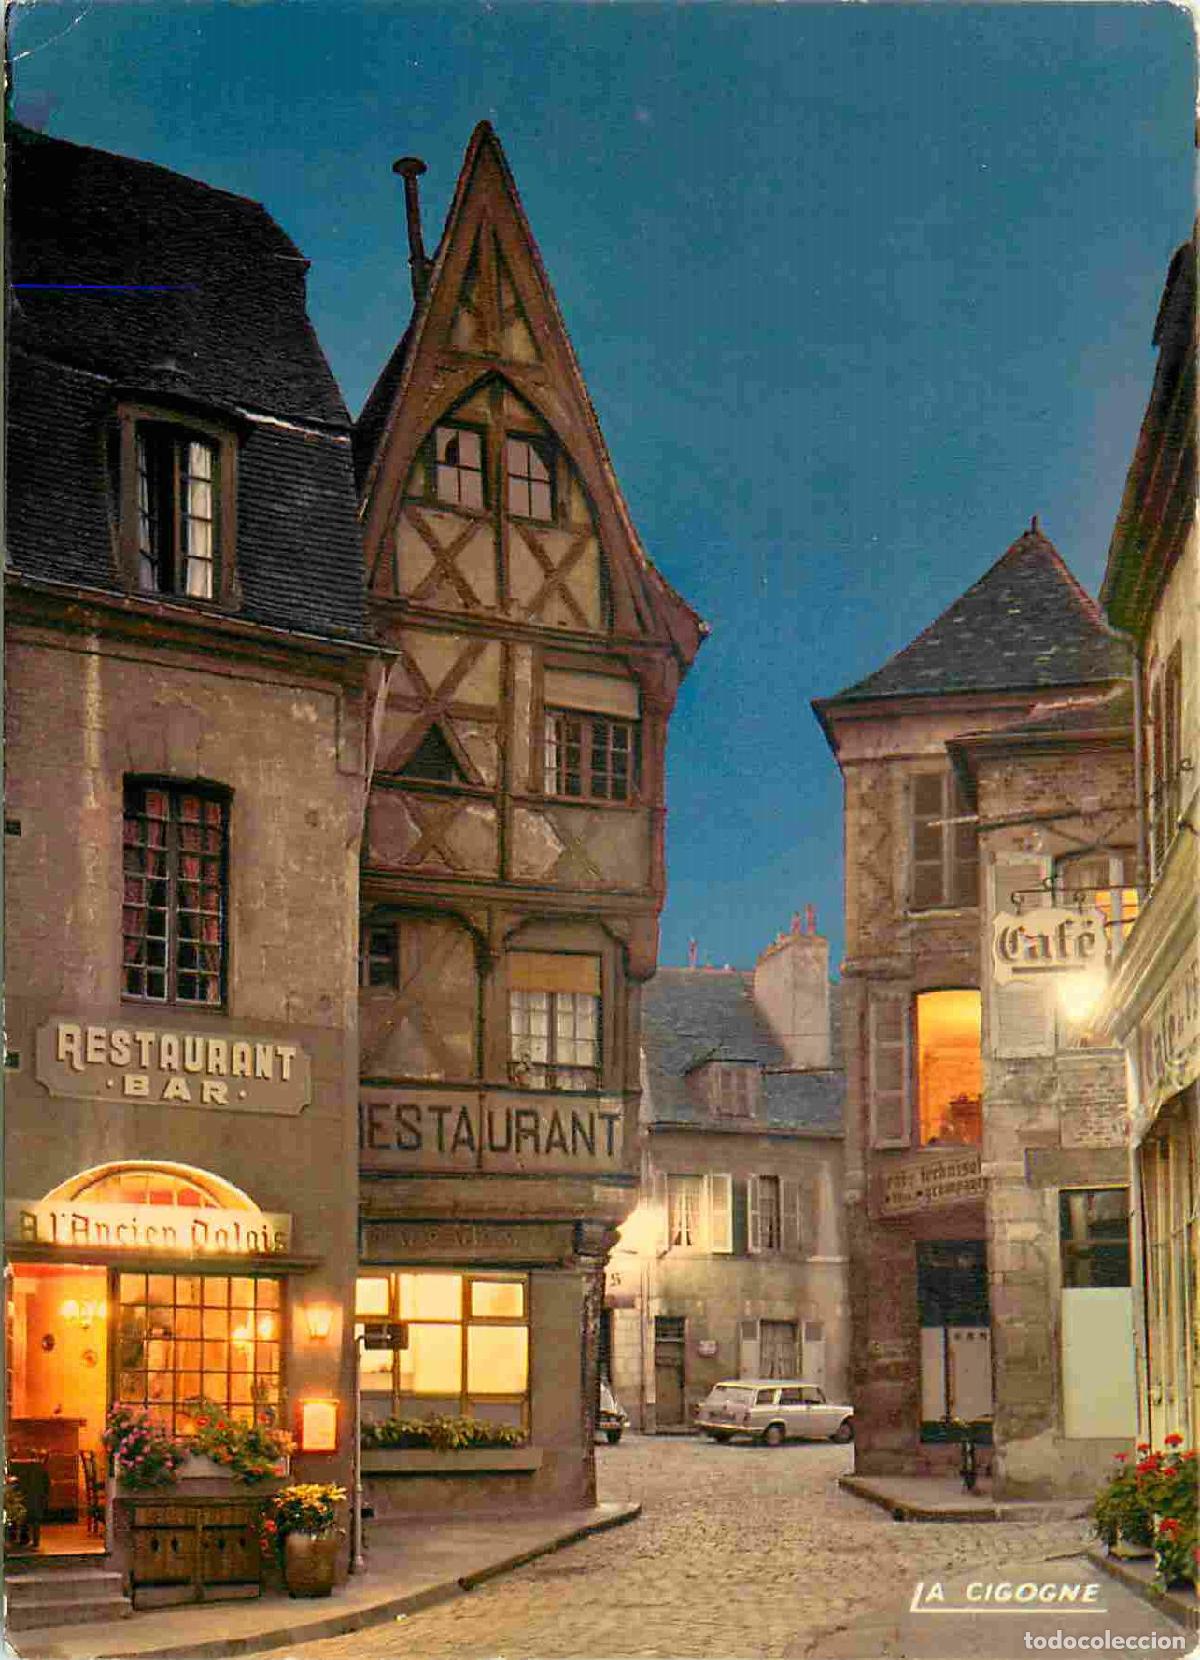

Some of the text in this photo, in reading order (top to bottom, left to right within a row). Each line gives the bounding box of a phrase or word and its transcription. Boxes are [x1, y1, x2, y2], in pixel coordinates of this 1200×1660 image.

[999, 919, 1096, 962] Café
[57, 1023, 297, 1081] RESTAURANT
[124, 1074, 229, 1105] BAR
[359, 1102, 623, 1158] ESTAURANT
[19, 1210, 39, 1243] A
[49, 1211, 178, 1248] l'Ancien
